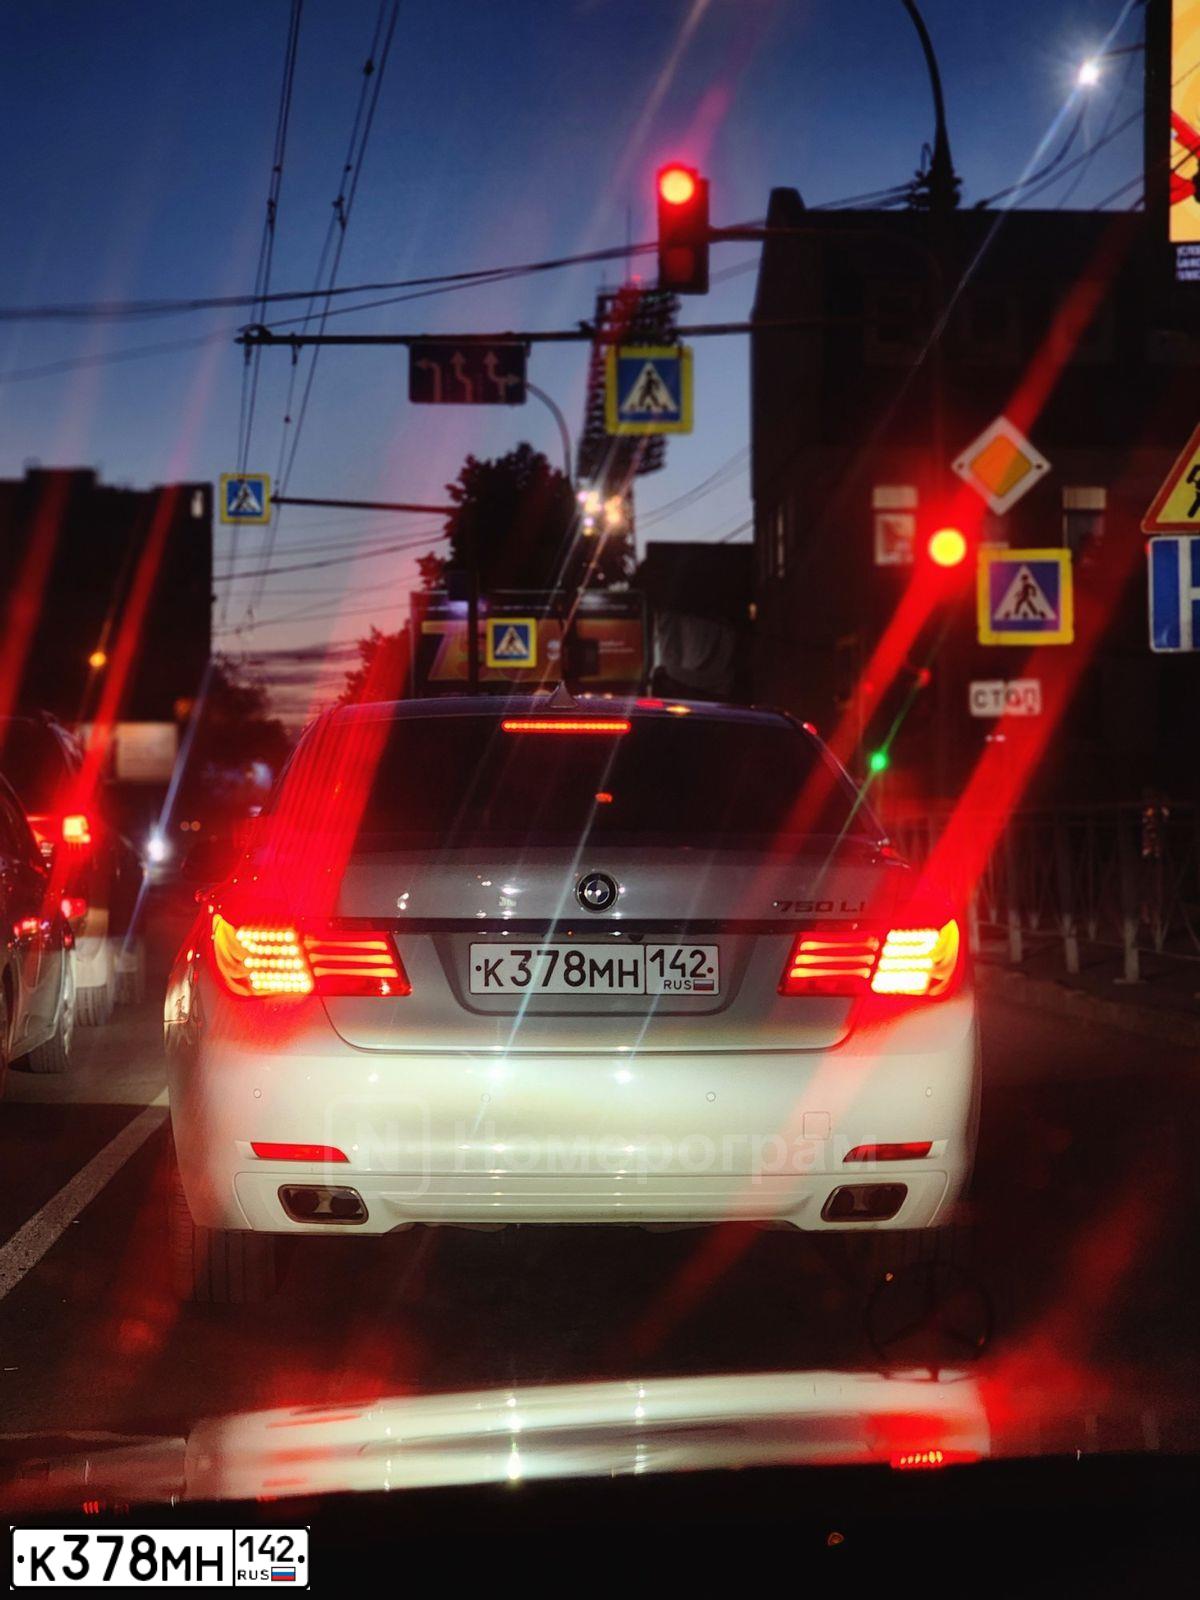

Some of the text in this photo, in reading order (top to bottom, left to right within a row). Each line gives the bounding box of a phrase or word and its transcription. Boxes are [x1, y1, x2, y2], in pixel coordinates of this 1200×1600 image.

[484, 950, 639, 988] К378МН
[650, 948, 706, 978] 142
[663, 979, 692, 990] RUS
